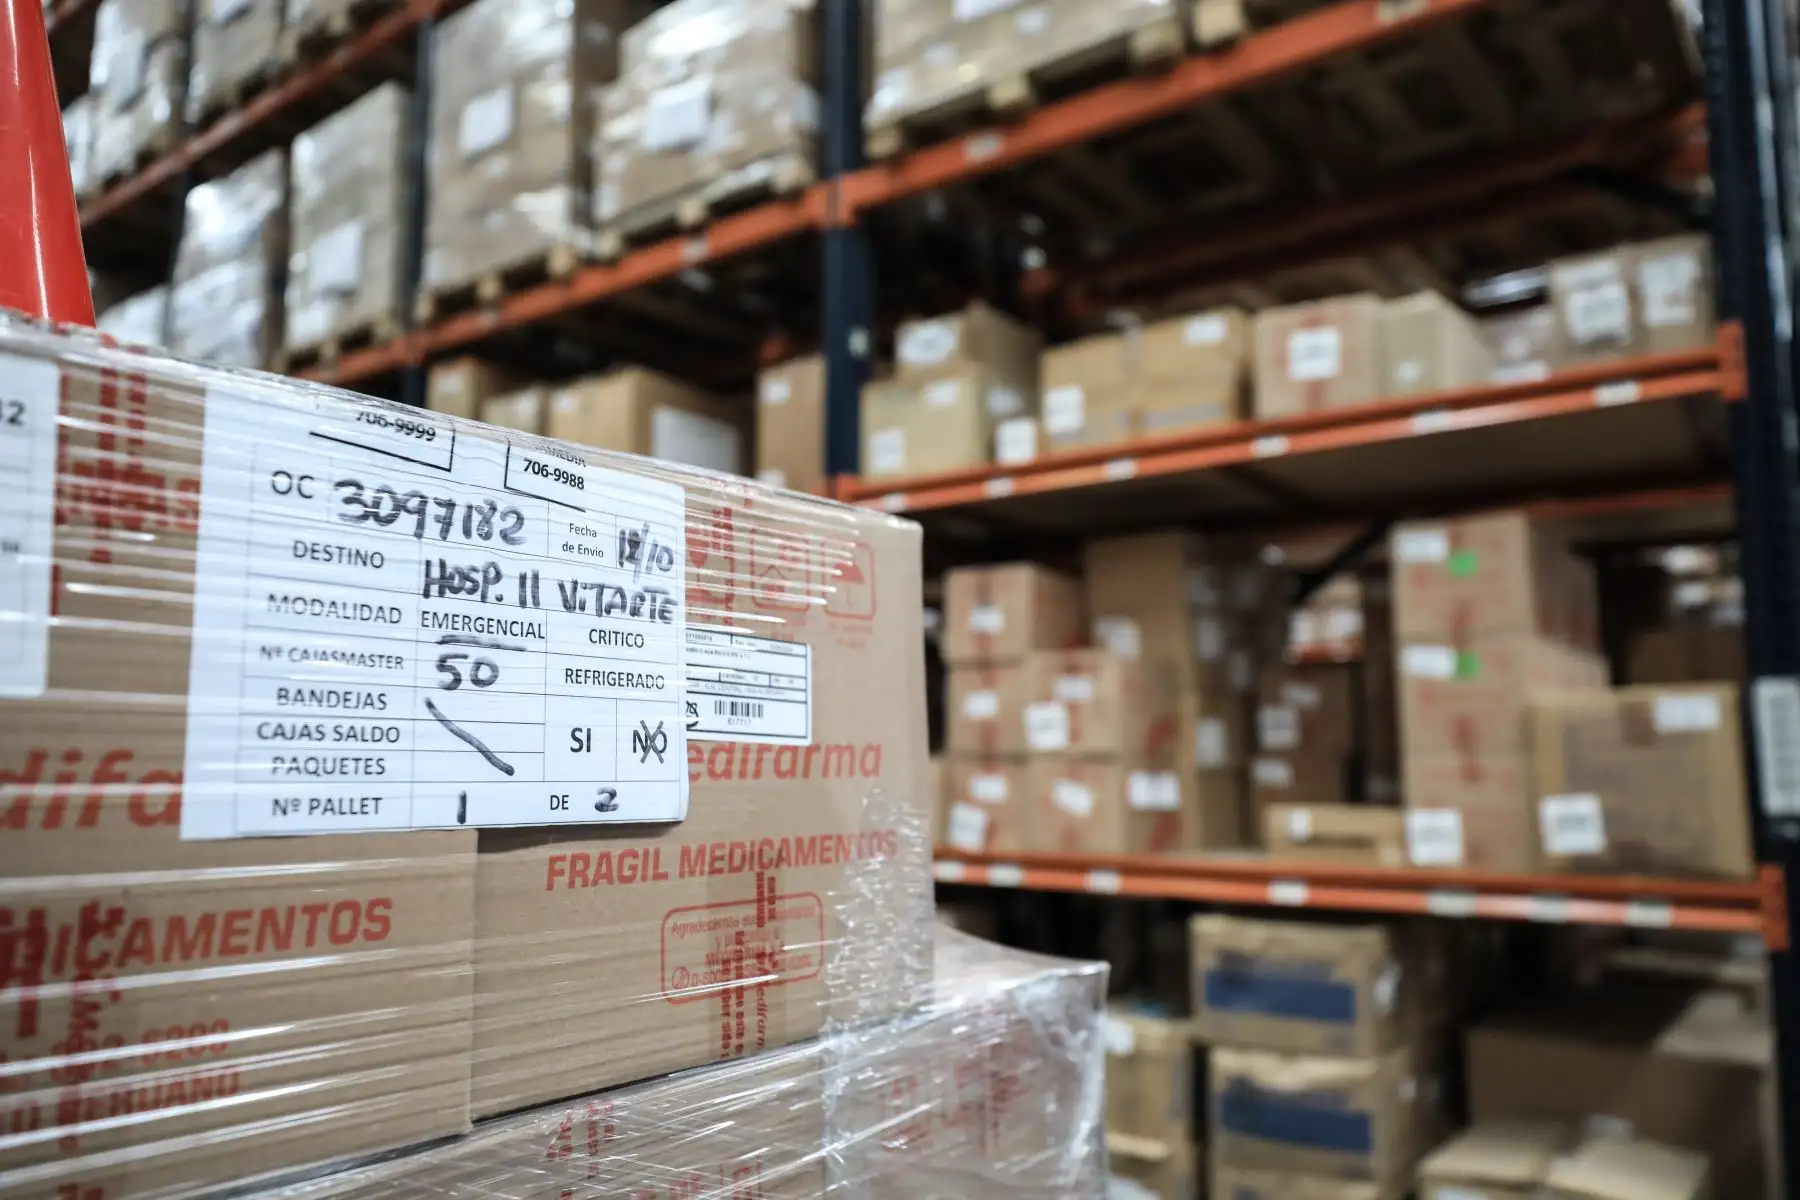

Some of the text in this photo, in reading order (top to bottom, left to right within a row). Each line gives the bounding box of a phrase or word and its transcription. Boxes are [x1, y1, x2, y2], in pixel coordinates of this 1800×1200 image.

[270, 470, 315, 499] OC
[523, 458, 585, 490] 706-9988
[334, 478, 526, 546] 3097182
[569, 523, 598, 538] Fecha
[292, 540, 385, 569] DESTINO
[562, 541, 604, 558] de Envio
[266, 593, 402, 625] MODALIDAD
[420, 610, 546, 640] EMERGENCIAL
[588, 628, 645, 649] CRITICO
[436, 653, 500, 691] 50
[564, 668, 666, 690] REFRIGERADO
[276, 688, 388, 711] BANDEJAS
[256, 722, 401, 744] CAJAS SALDO
[569, 728, 593, 754] SI
[632, 728, 669, 755] NO
[271, 756, 387, 777] PAQUETES
[307, 797, 383, 816] PALLET
[549, 795, 570, 811] DE
[594, 787, 620, 813] 2
[545, 829, 898, 892] FRAGIL MEDICAMENTOS
